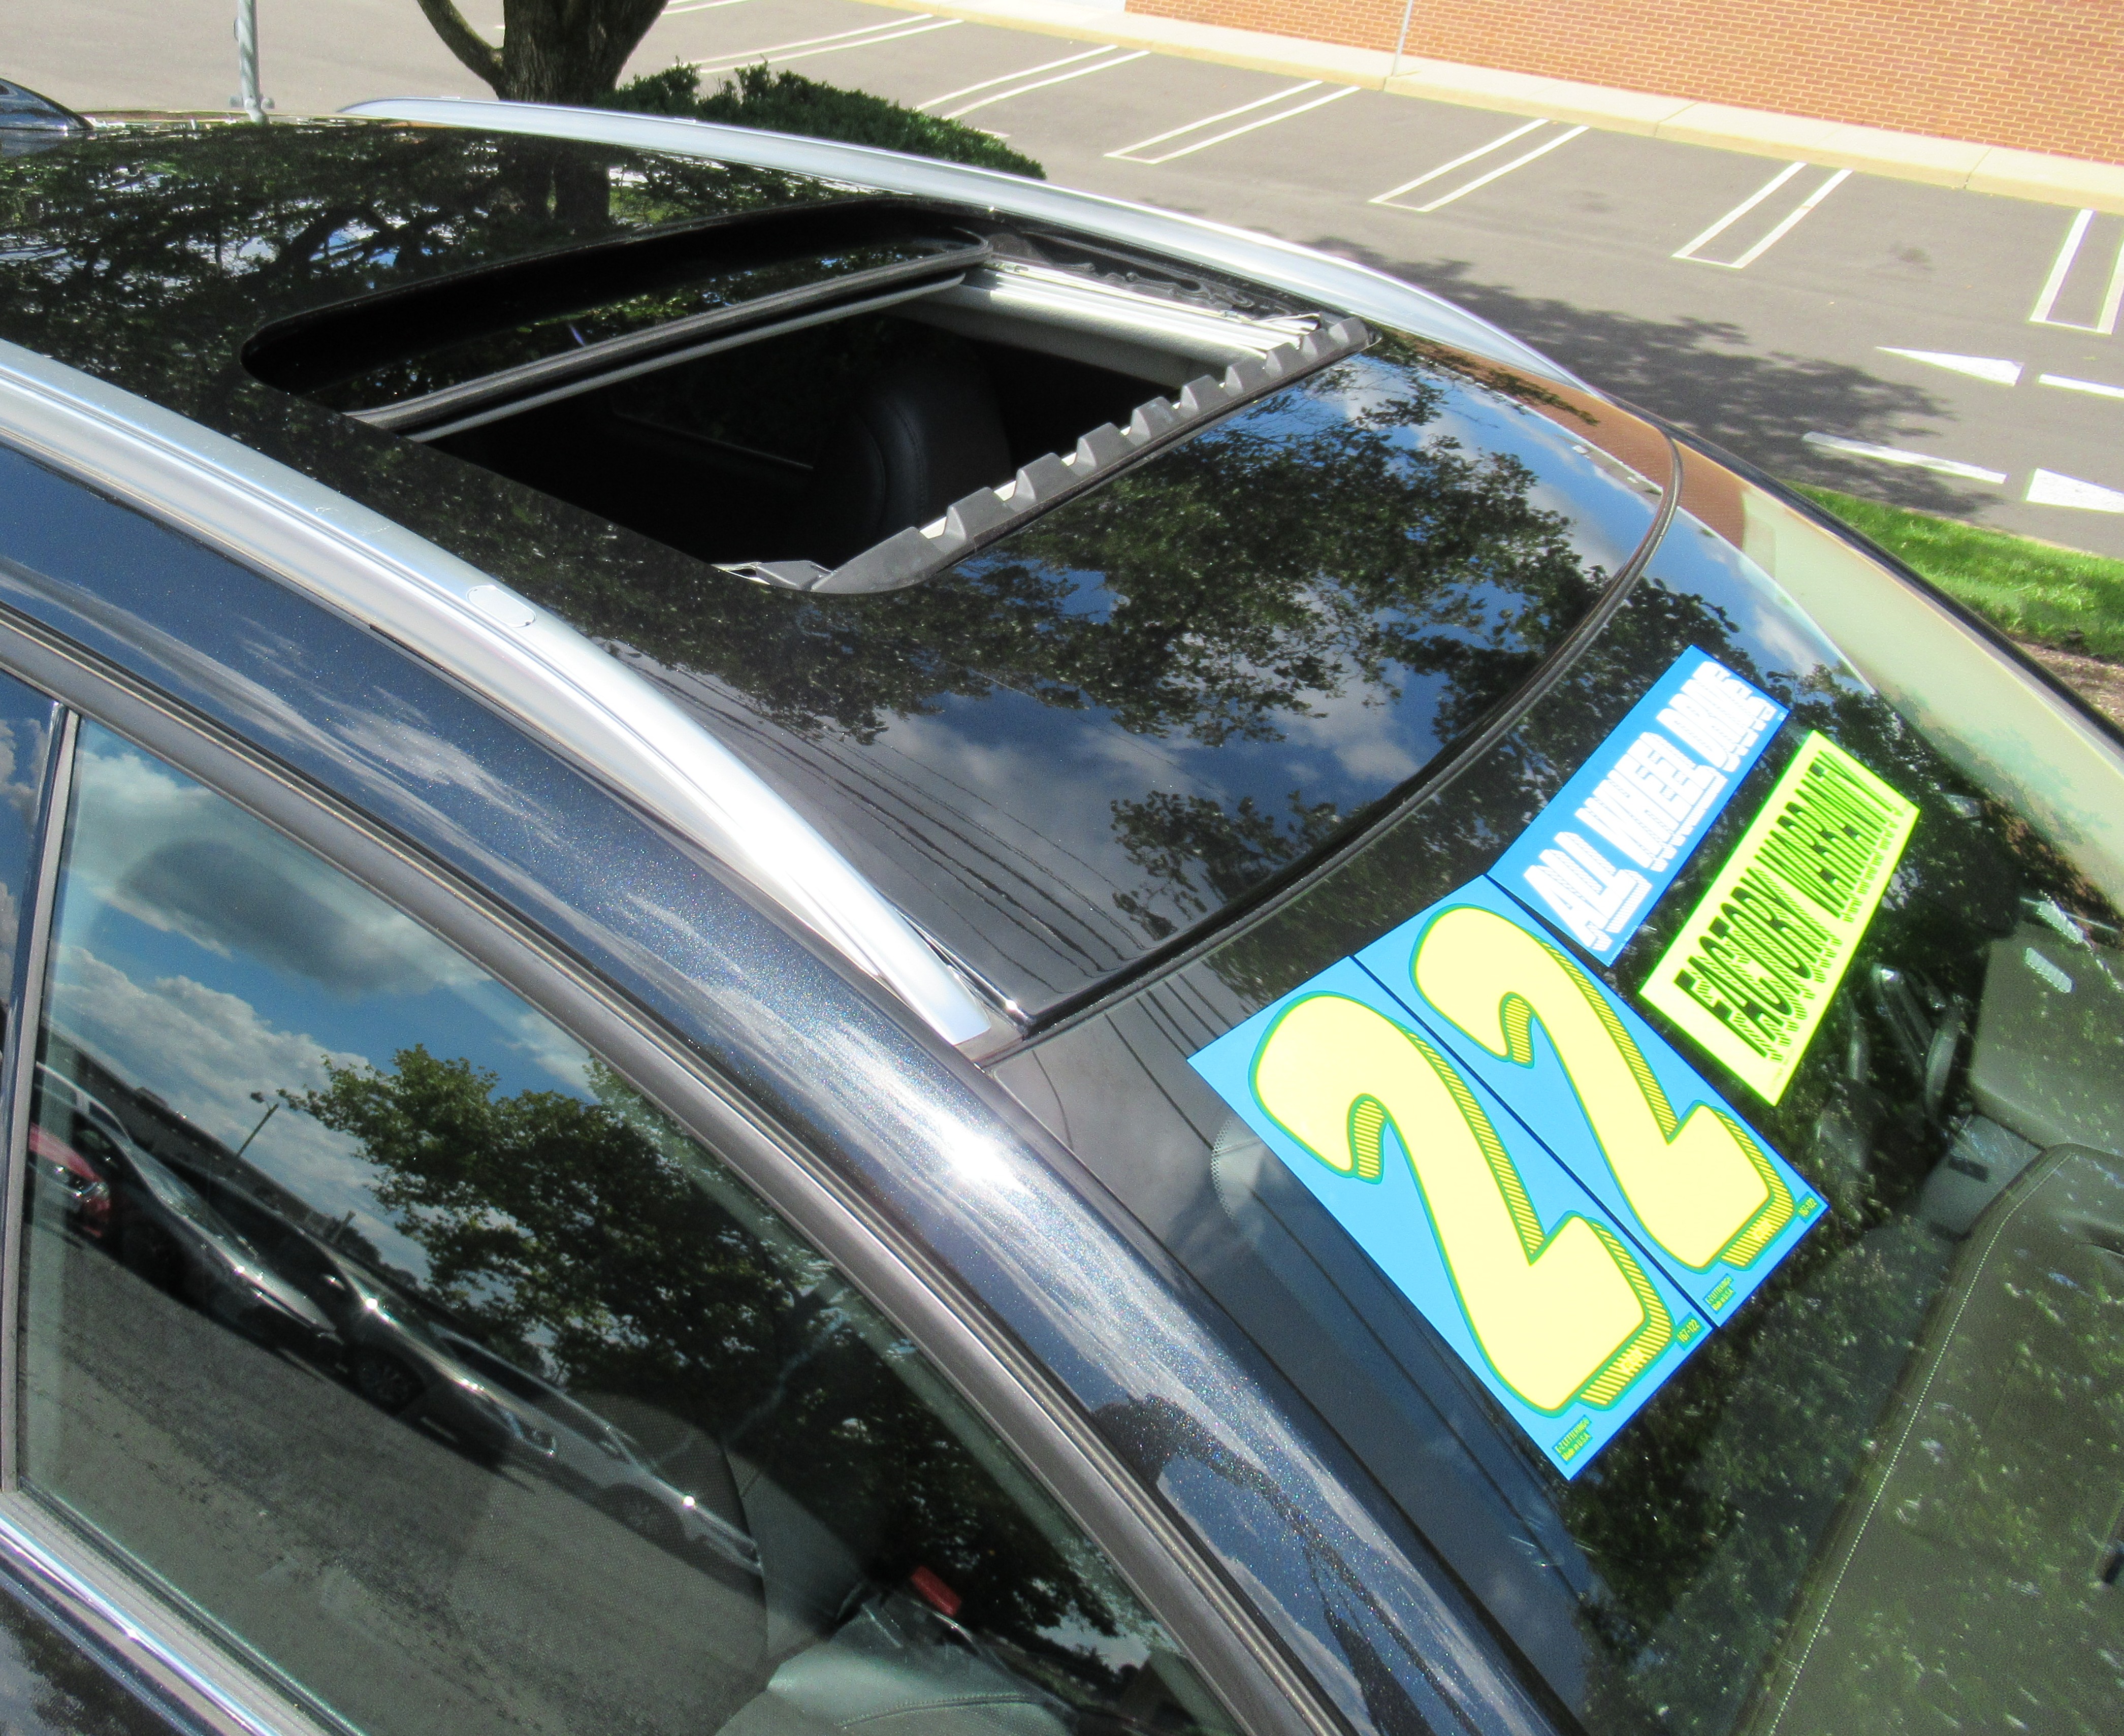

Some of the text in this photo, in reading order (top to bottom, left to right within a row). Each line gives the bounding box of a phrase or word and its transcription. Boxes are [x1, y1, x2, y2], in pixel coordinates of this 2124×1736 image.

[1524, 661, 1777, 951] ALL WHEEL DRIVE
[1674, 750, 1904, 1062] FACTORY WARRANTY
[1677, 1319, 1700, 1342] 167-122
